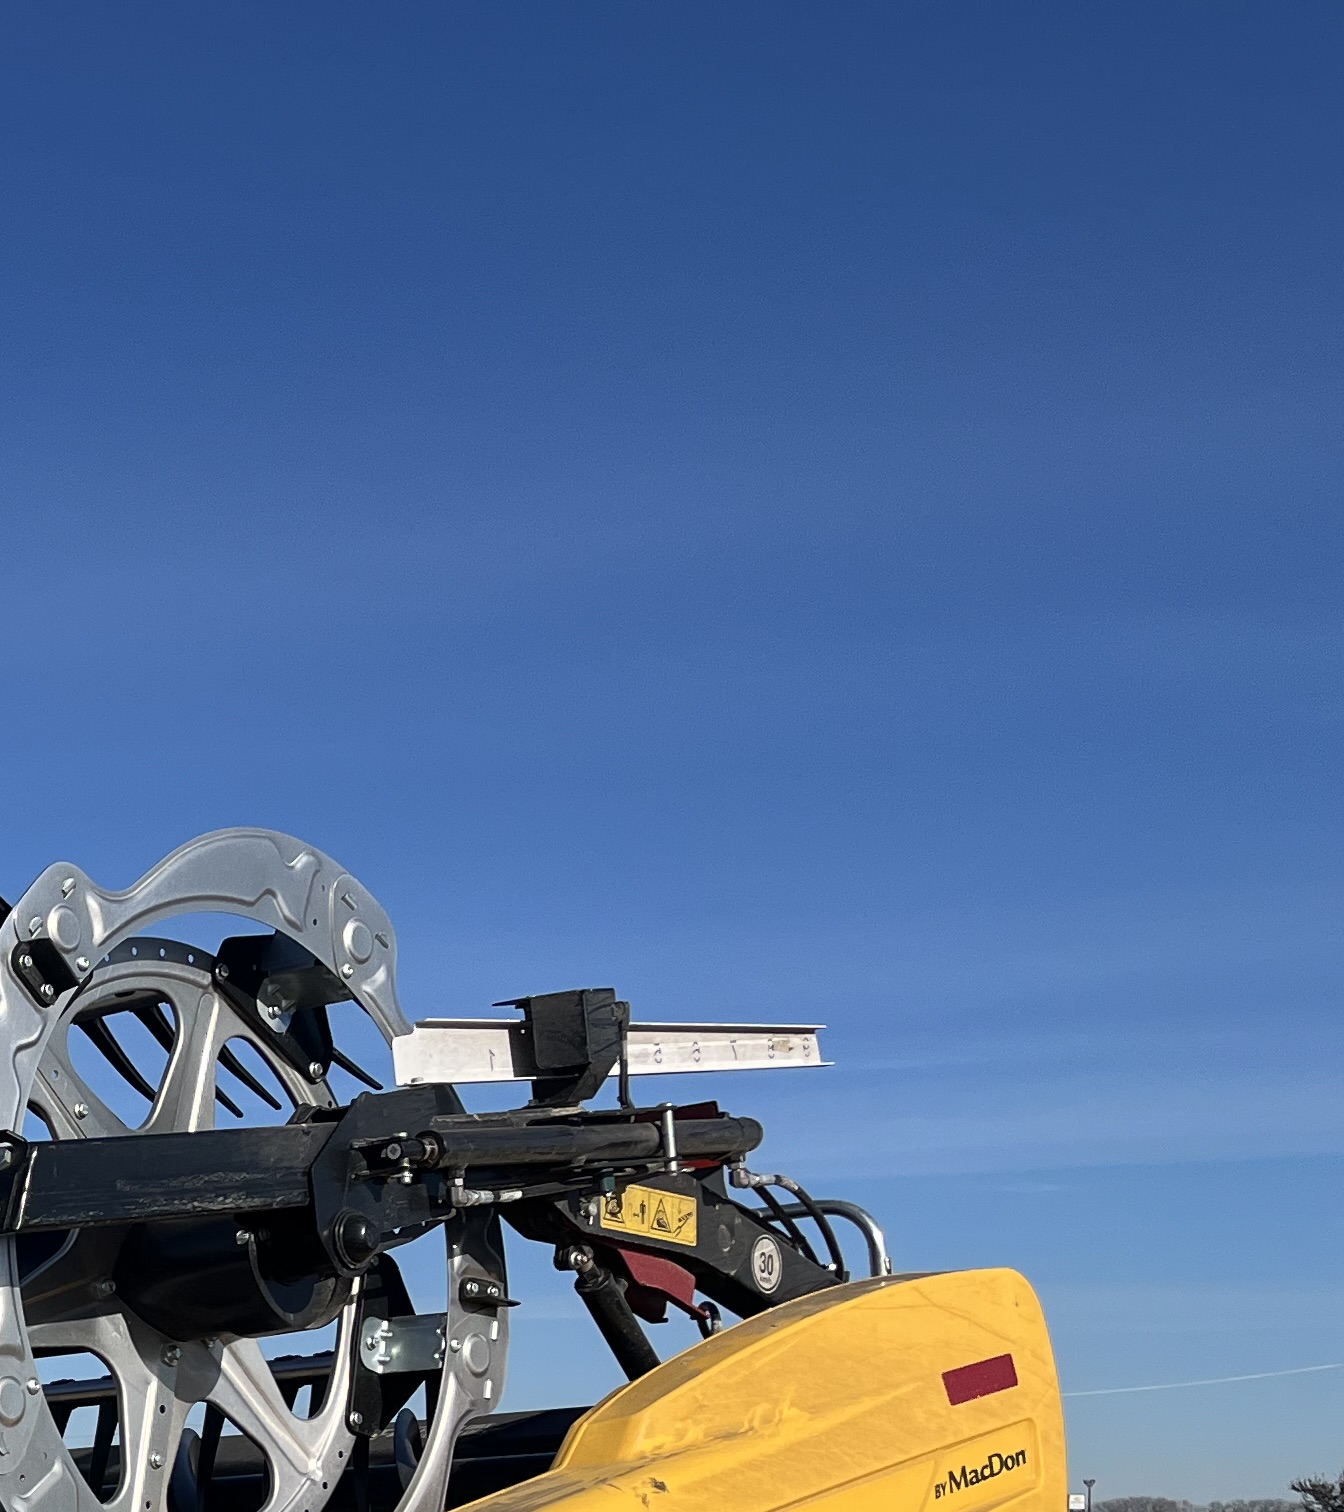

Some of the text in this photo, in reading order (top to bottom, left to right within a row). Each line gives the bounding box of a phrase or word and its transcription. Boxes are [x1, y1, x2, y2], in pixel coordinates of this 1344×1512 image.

[759, 1251, 774, 1276] 30
[934, 1449, 1027, 1500] BY MacDon
